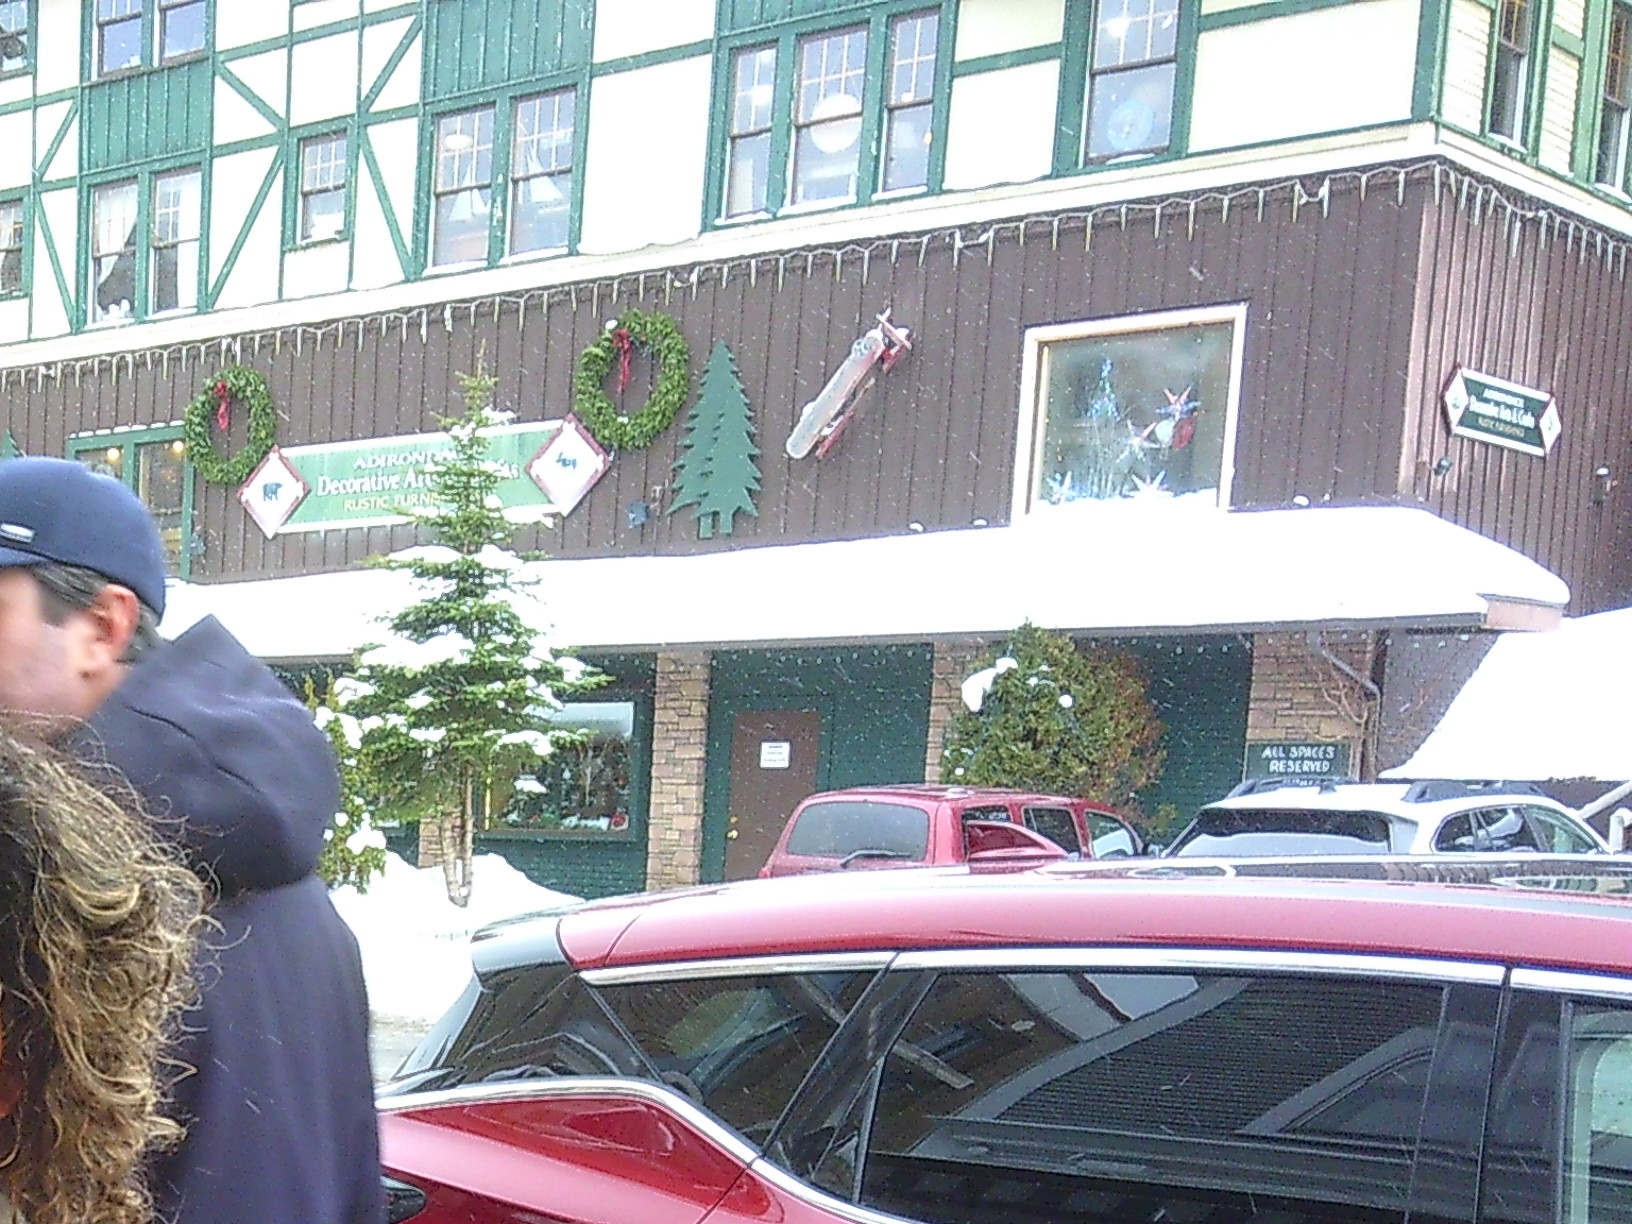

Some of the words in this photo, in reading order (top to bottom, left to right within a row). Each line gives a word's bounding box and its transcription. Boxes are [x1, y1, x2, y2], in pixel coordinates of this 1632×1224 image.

[353, 449, 466, 470] ADIRONDA
[316, 469, 400, 496] Decorative
[344, 495, 390, 512] RUSTIC
[1261, 746, 1286, 759] ALL
[1289, 746, 1335, 759] SPACES
[1269, 760, 1331, 773] RESERVED
